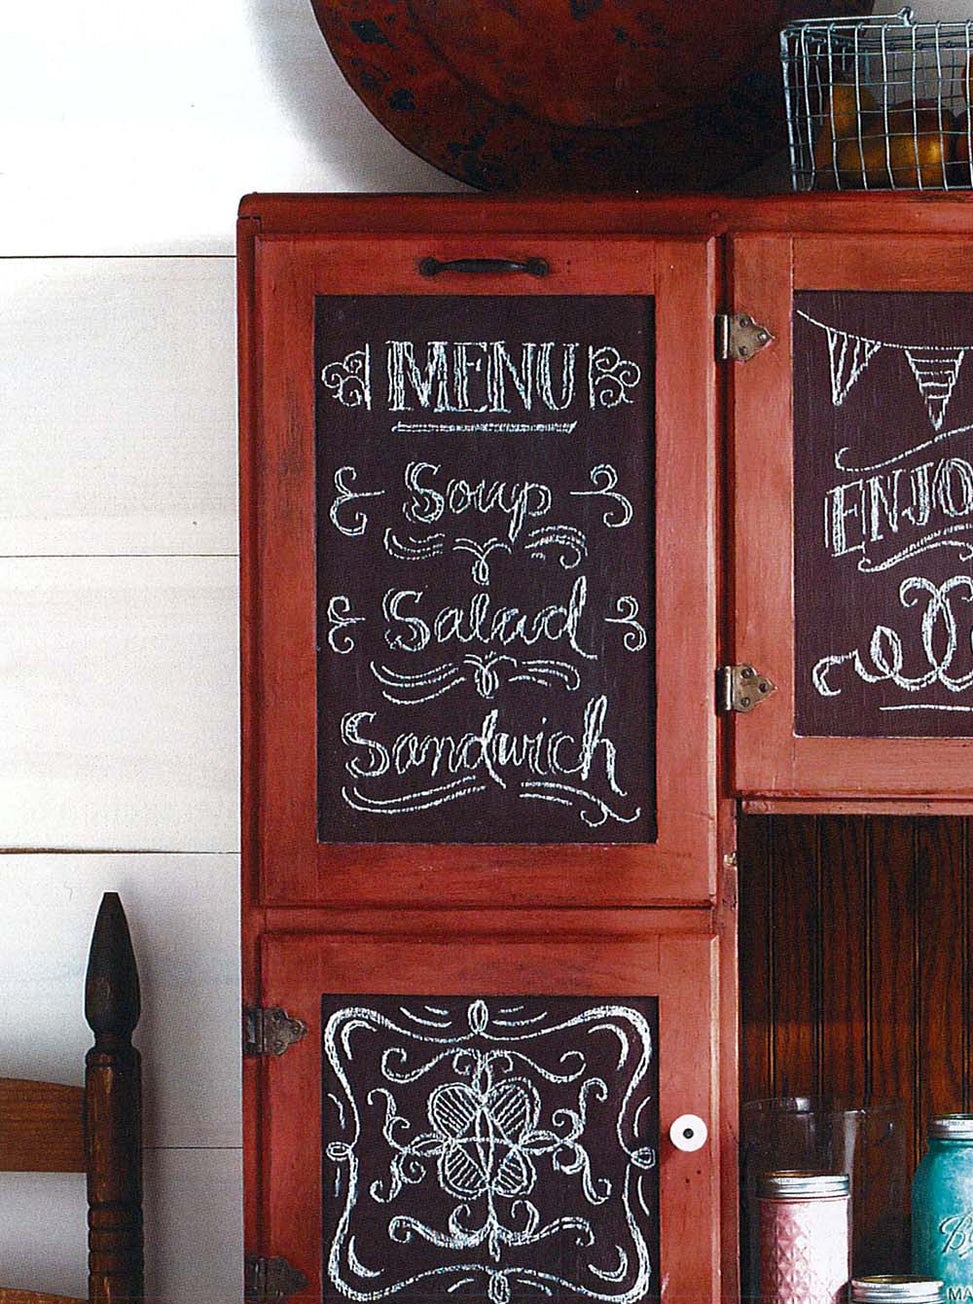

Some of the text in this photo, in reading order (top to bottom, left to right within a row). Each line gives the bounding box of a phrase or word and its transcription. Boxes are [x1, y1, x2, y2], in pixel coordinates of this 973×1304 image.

[385, 340, 578, 413] MENU
[402, 462, 551, 543] Soup
[383, 576, 597, 660] Salad
[340, 696, 627, 796] Sandwich
